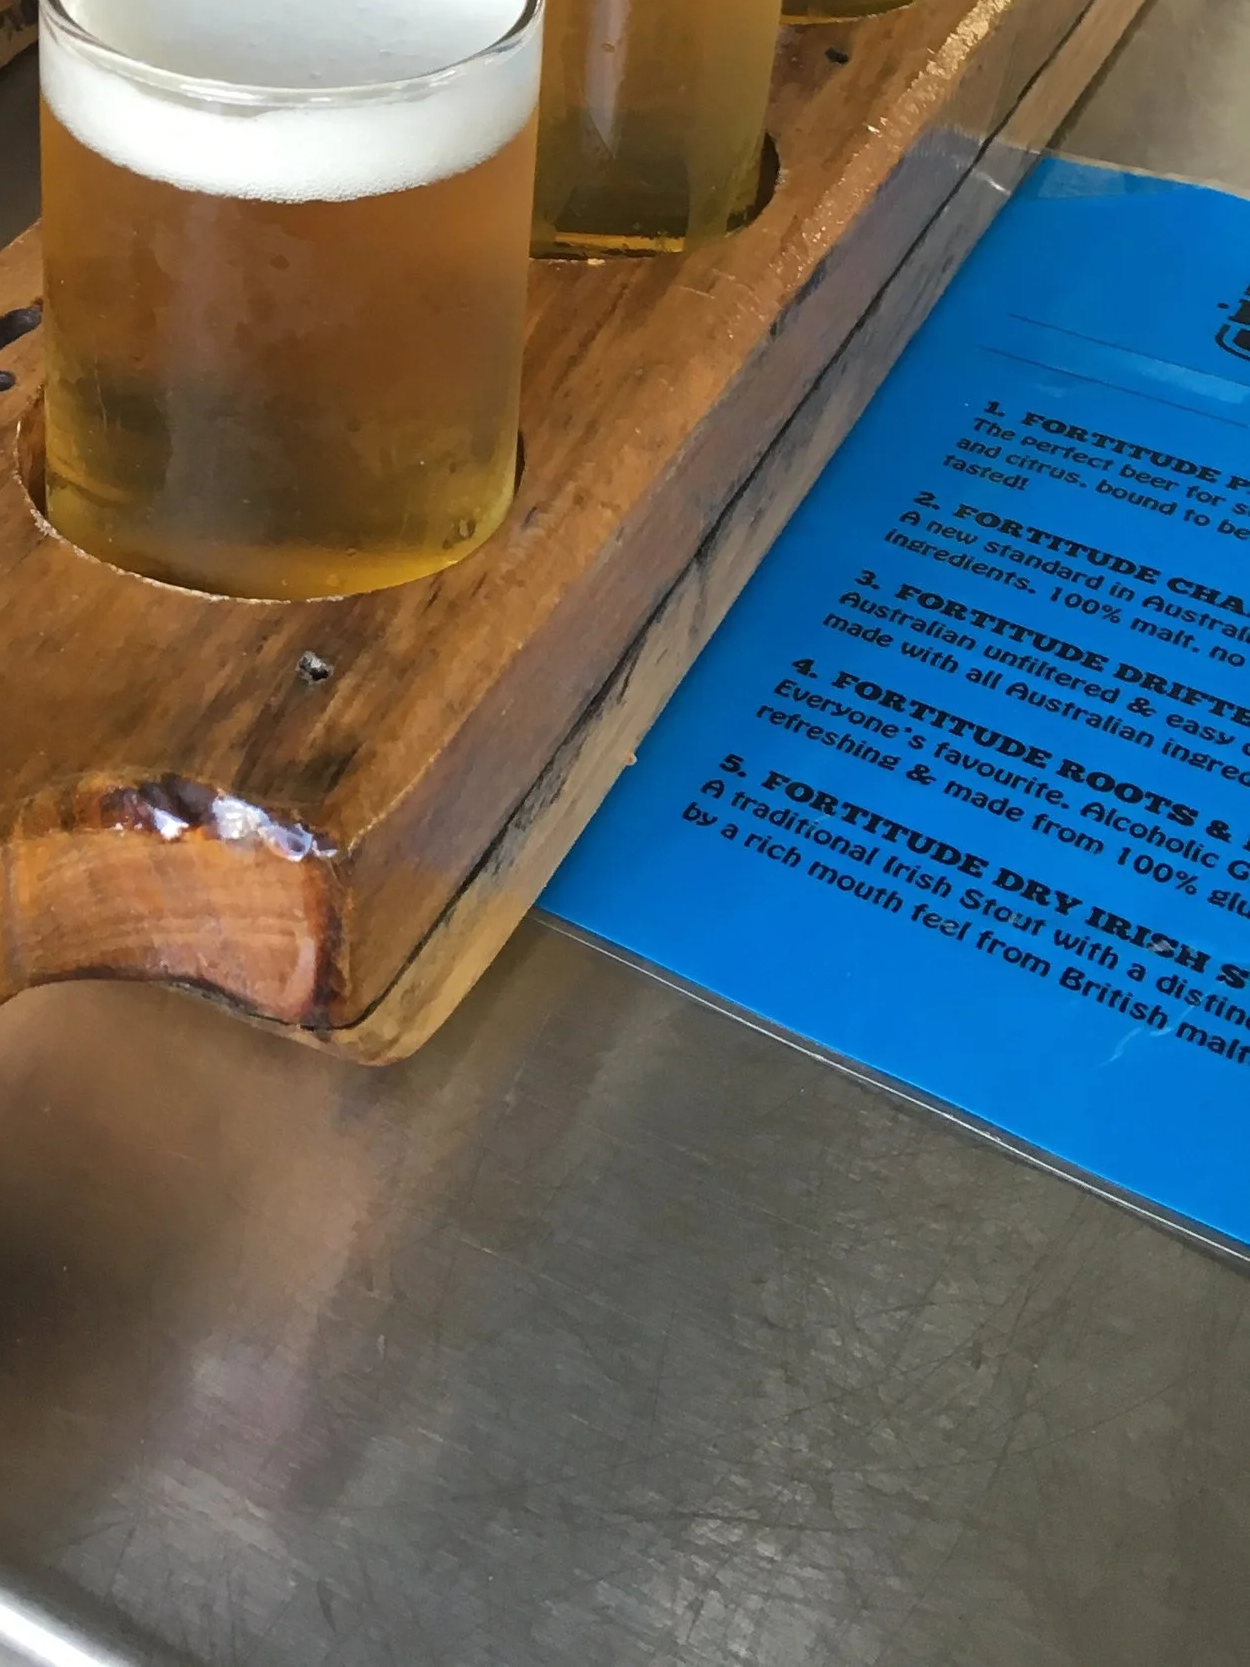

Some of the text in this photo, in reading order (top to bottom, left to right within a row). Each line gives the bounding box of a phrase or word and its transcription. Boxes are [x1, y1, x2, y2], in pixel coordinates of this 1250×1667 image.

[942, 454, 1030, 491] tasted!
[956, 437, 1003, 459] and
[1095, 478, 1179, 516] bound
[1182, 508, 1211, 527] to
[1216, 518, 1250, 541] be
[973, 416, 1016, 441] The
[1020, 434, 1114, 472] perfect
[1119, 463, 1180, 492] beer
[1185, 485, 1227, 507] for
[983, 400, 1250, 495] 1. FORTITUDE P
[853, 569, 880, 591] 3.
[893, 583, 1110, 673] FORTITUDE
[883, 528, 1037, 595] ingredients.
[1049, 586, 1123, 625] 100%
[1208, 645, 1246, 668] no
[899, 510, 921, 527] A
[925, 520, 979, 545] new
[983, 539, 1105, 591] standard
[1108, 581, 1136, 603] in
[913, 490, 1250, 618] 2. FORTITUDE CHA
[822, 612, 894, 649] made
[900, 640, 960, 674] with
[964, 669, 1004, 690] all
[1005, 681, 1155, 749] Australian
[838, 591, 1236, 746] Australian unfiltered & easy
[755, 704, 902, 772] refreshing
[905, 763, 938, 786] &
[942, 779, 1026, 823] made
[1030, 813, 1105, 856] from
[1116, 846, 1199, 897] 100%
[773, 678, 927, 751] Everyone's
[932, 741, 1070, 810] favourite.
[1080, 801, 1220, 870] Alcoholic
[791, 658, 1233, 844] 4. FORTITUDE ROOTS &
[680, 801, 719, 827] by
[720, 822, 740, 842] a
[743, 831, 803, 868] rich
[806, 860, 905, 914] mouth
[910, 902, 973, 943] feel
[975, 929, 1053, 979] from
[1058, 966, 1169, 1031] British
[700, 778, 1250, 1032] A traditional Irish Stout with a distin
[718, 752, 748, 779] 5.
[760, 769, 990, 880] FORTITUDE
[991, 866, 1084, 917] DRY
[1084, 905, 1212, 975] IRISH
